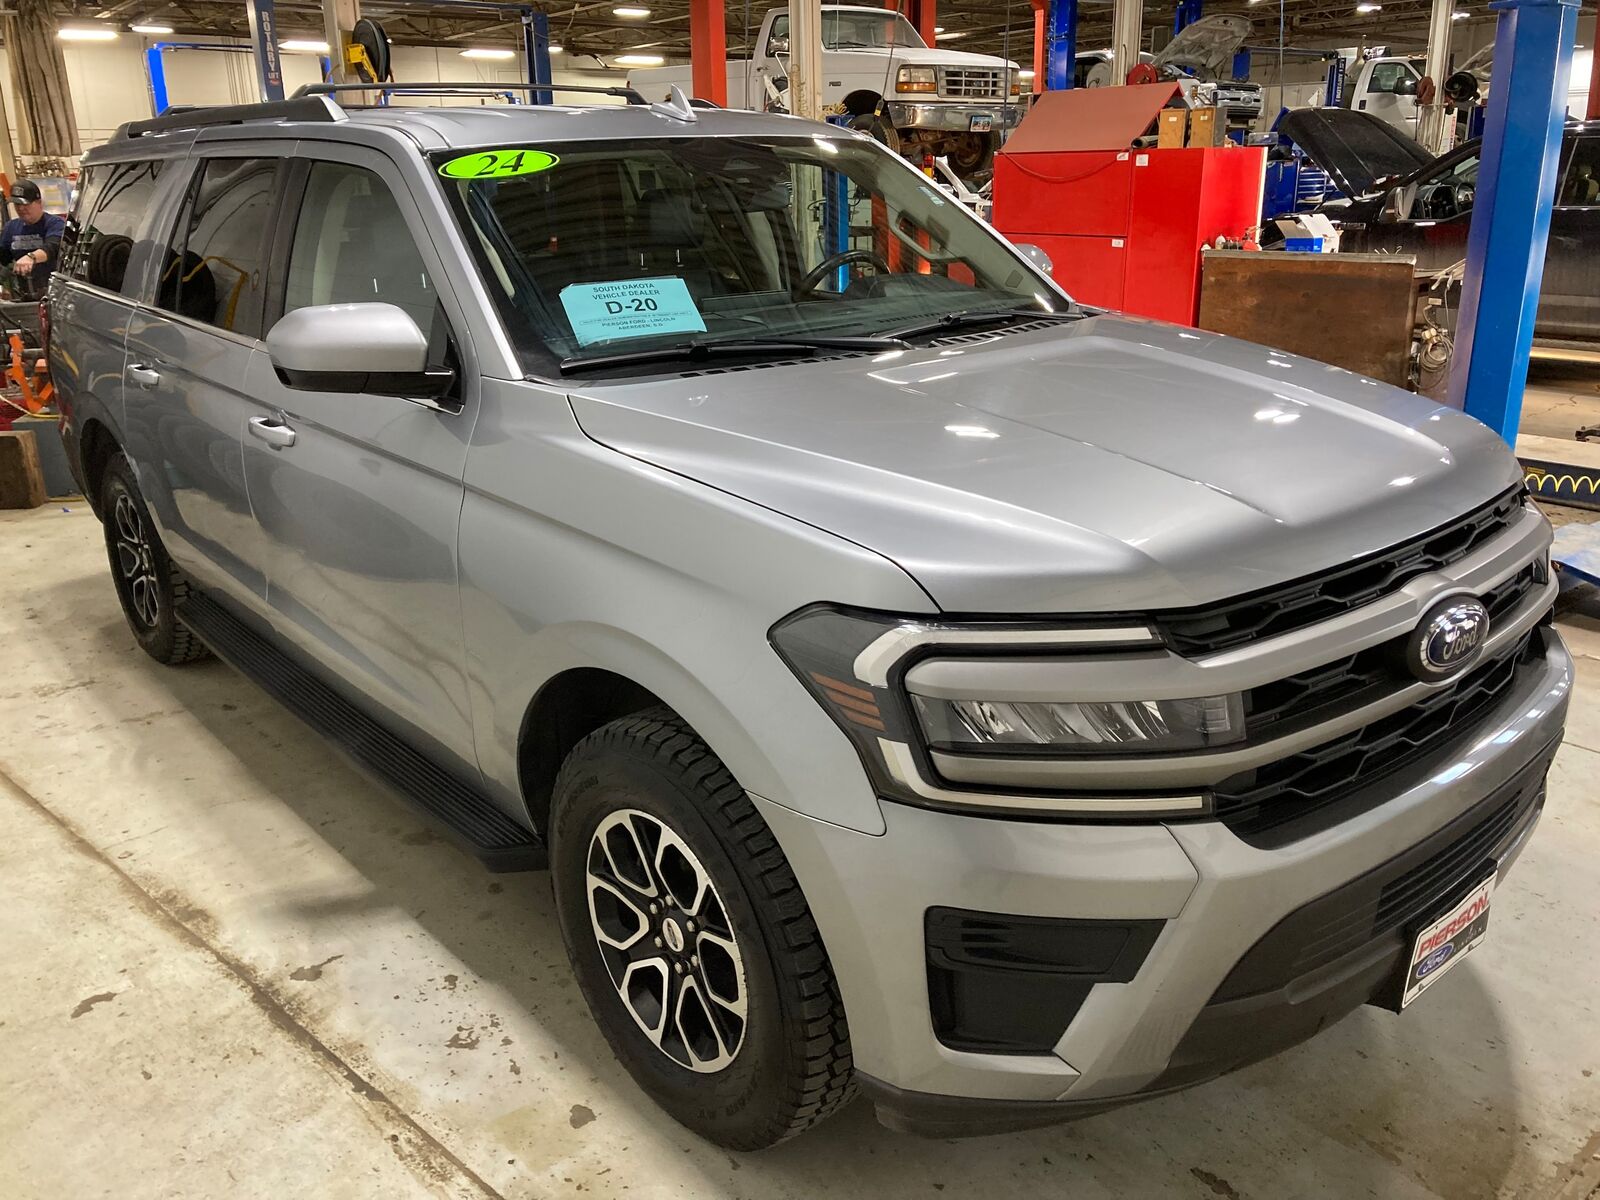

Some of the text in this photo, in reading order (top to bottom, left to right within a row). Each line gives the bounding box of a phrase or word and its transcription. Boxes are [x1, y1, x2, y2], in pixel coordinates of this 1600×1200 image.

[261, 11, 275, 71] ROTARY
[474, 151, 526, 176] 24
[592, 289, 661, 300] VEHICLE DEALER
[593, 285, 621, 293] SOUTH
[605, 298, 658, 315] D-20
[1417, 891, 1489, 961] PIERSON
